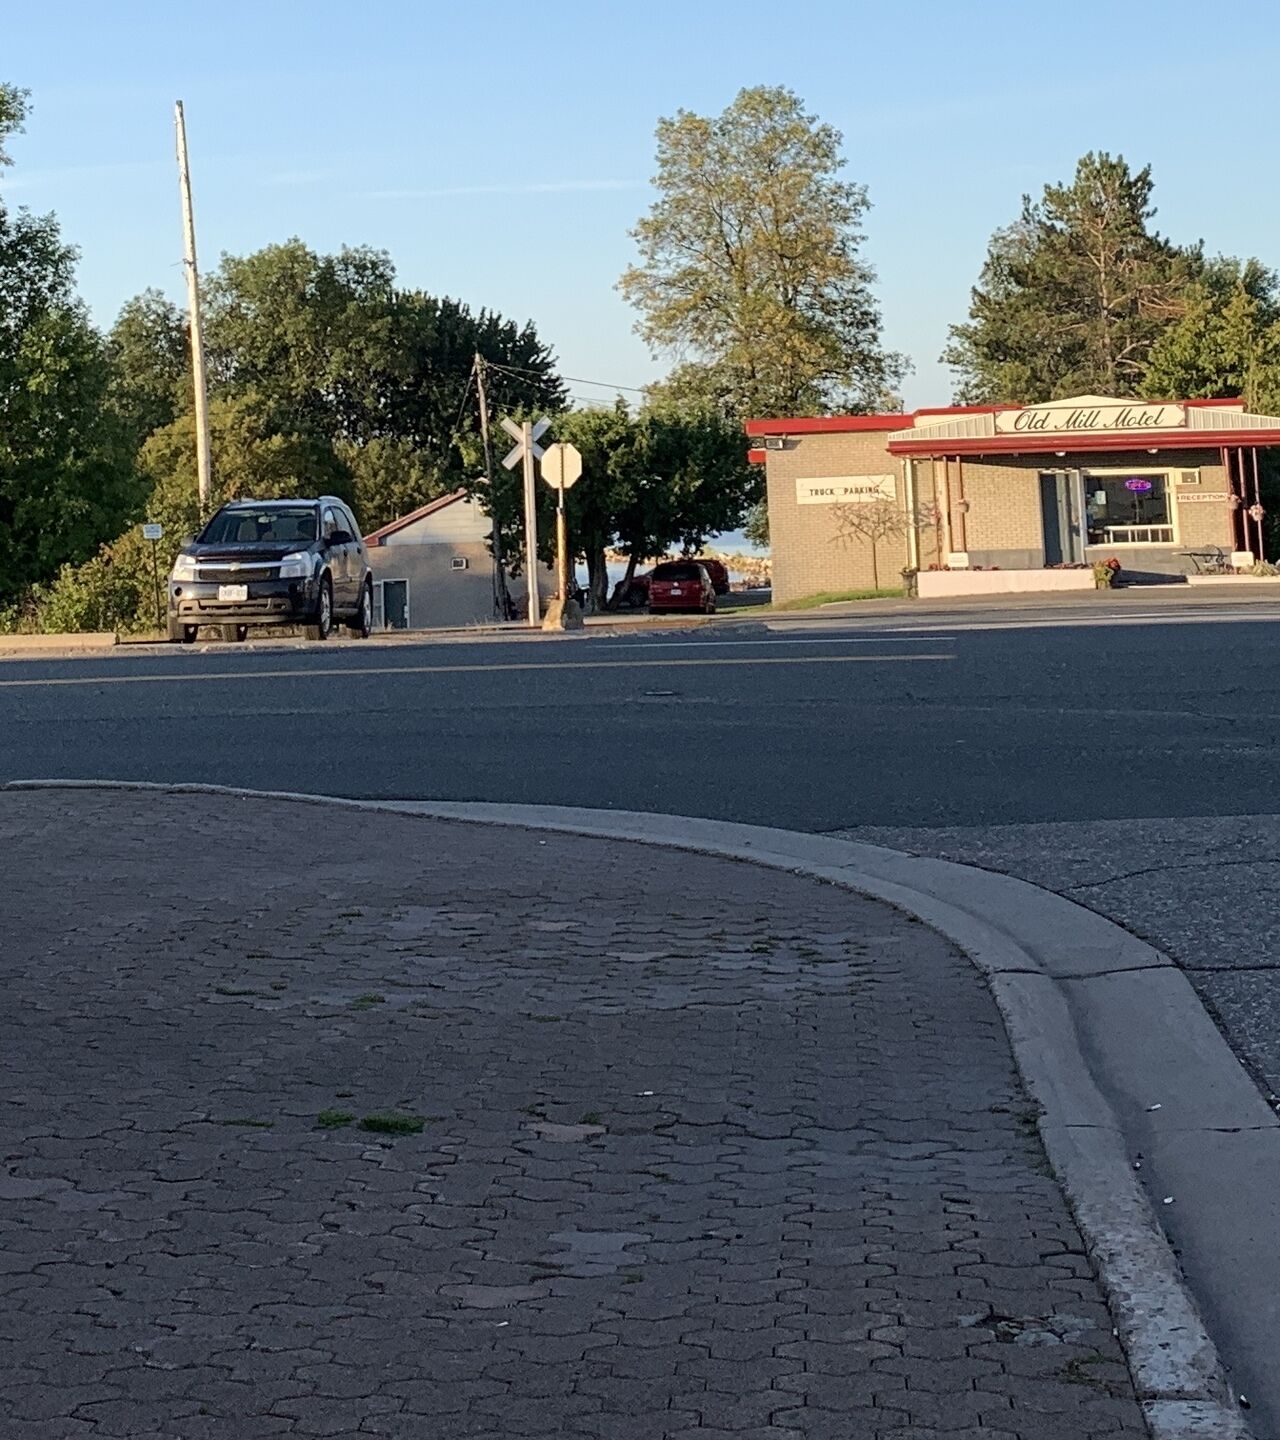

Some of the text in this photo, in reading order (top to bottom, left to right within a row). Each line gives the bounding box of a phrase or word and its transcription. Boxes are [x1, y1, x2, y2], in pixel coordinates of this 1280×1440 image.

[1014, 407, 1165, 431] Old Mill Motel
[809, 486, 880, 497] TRUCK PARKING
[1180, 493, 1226, 501] RECEPTION
